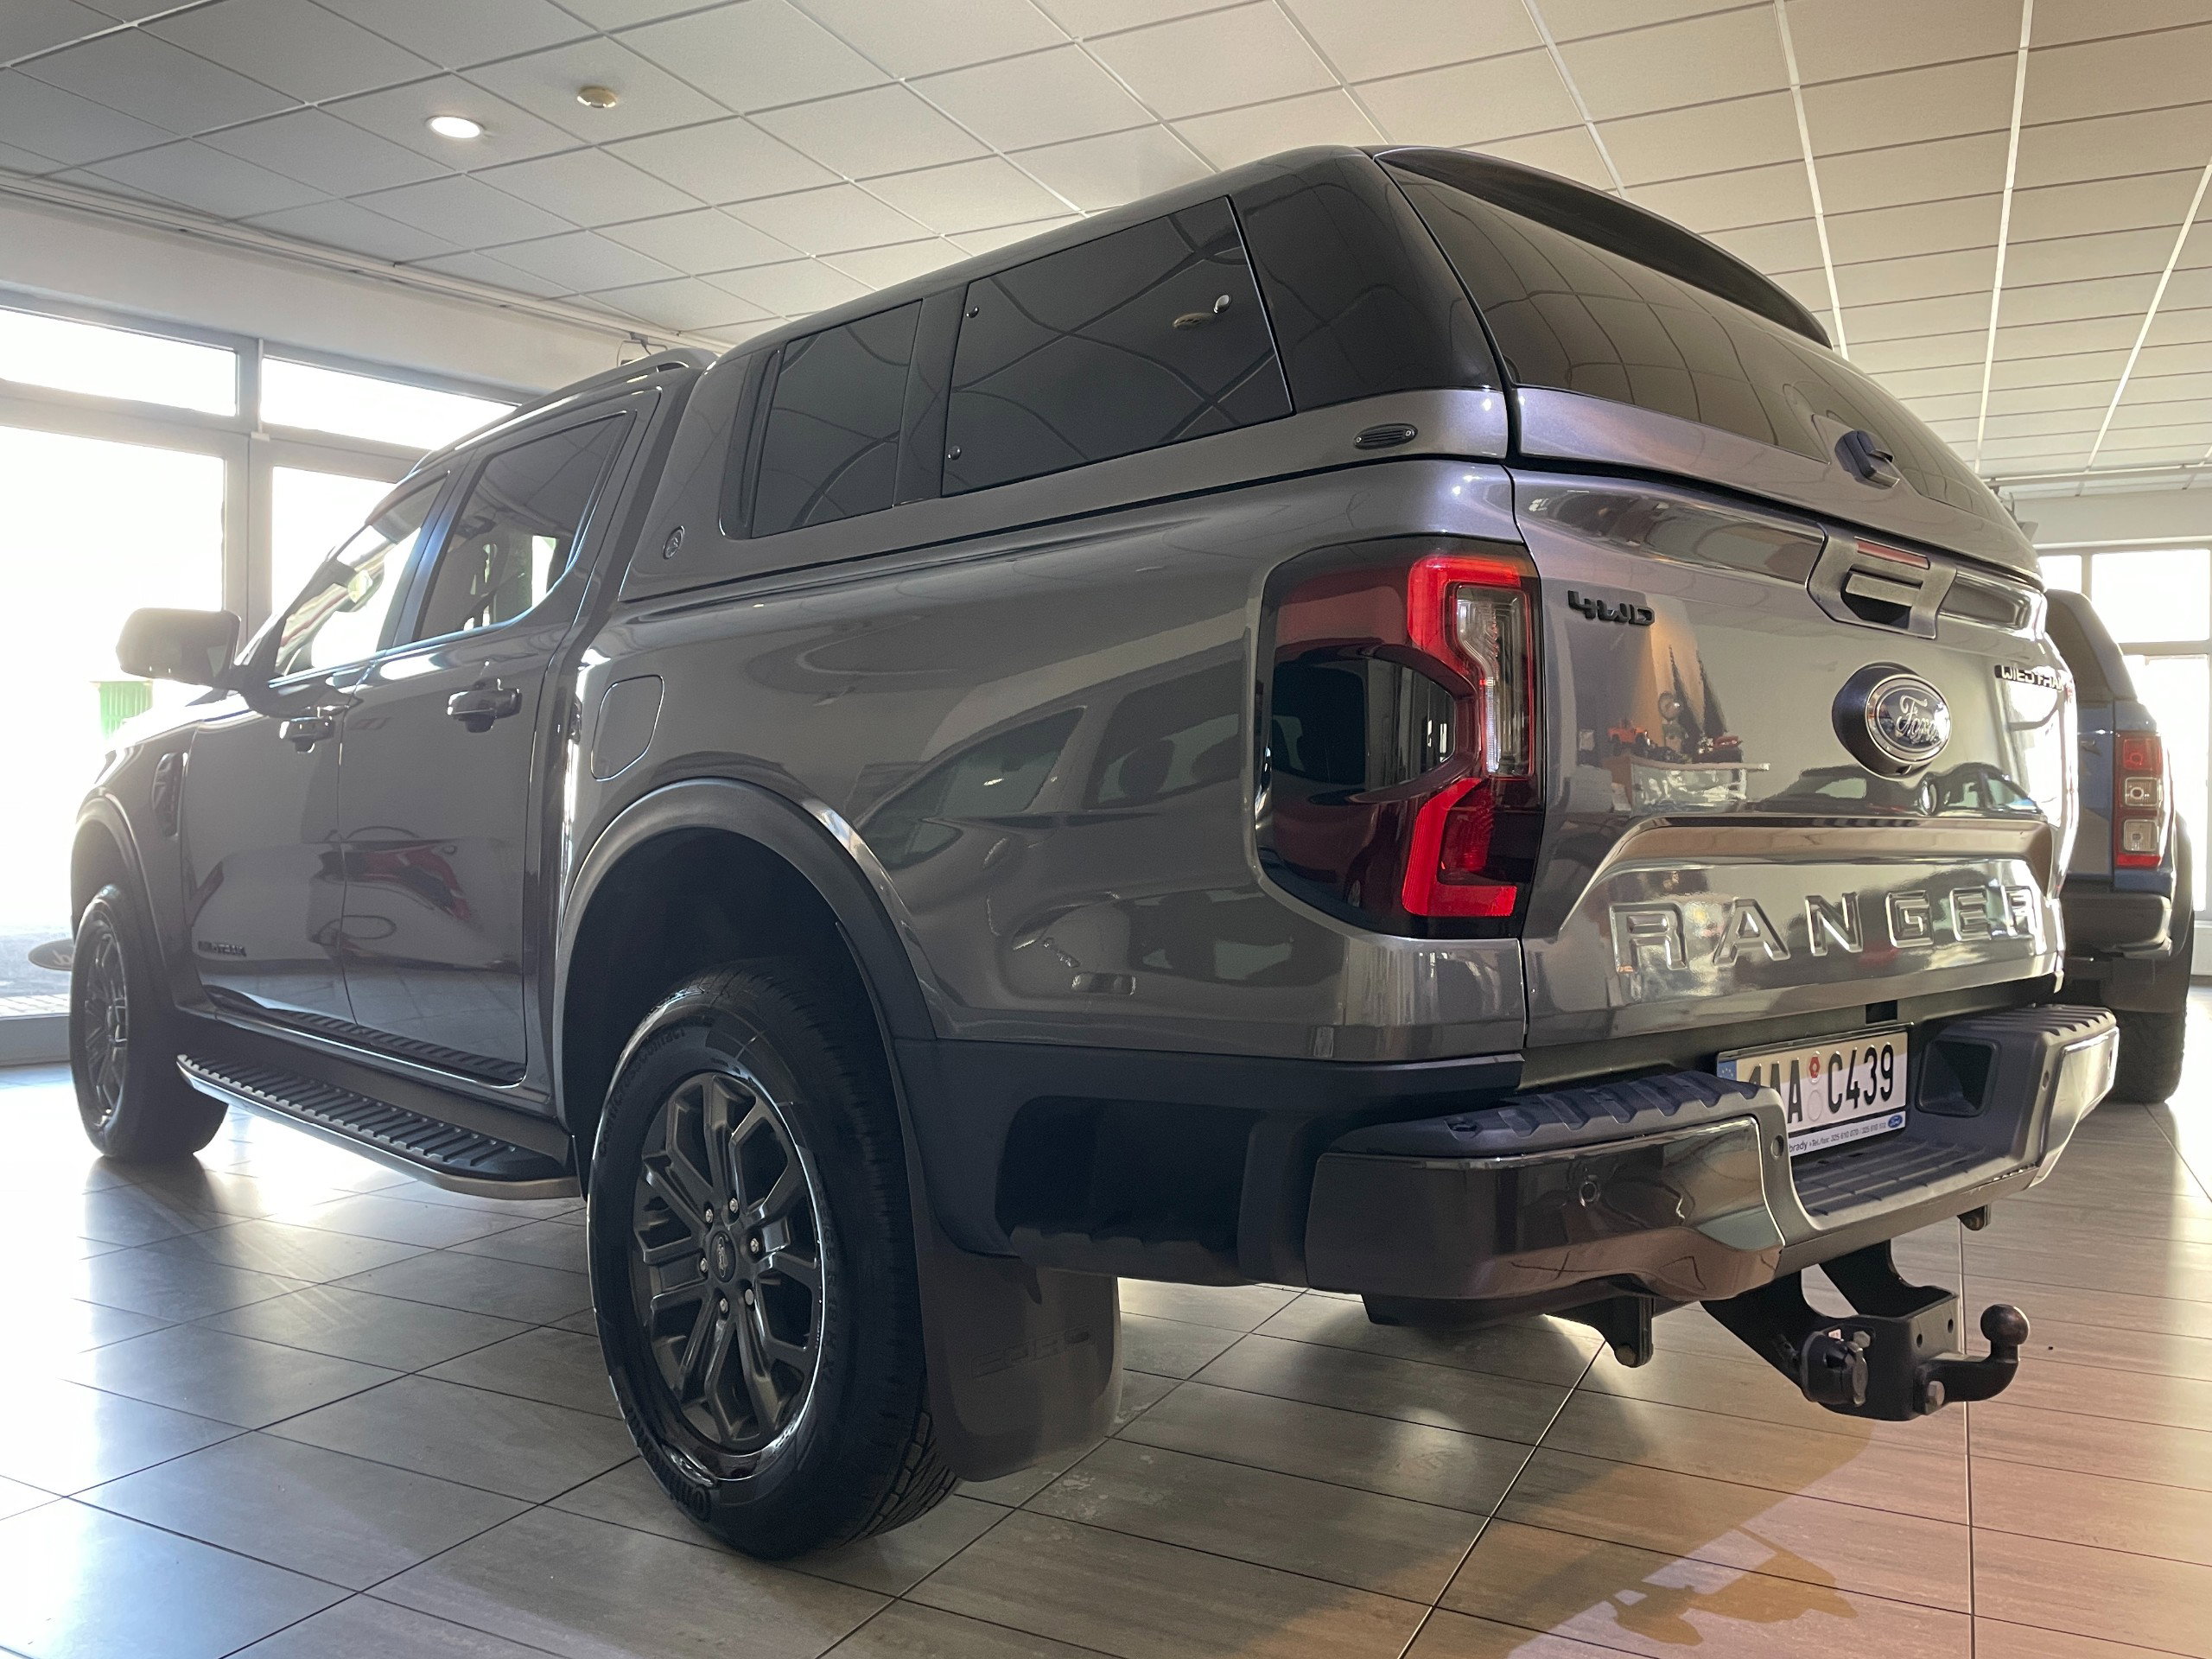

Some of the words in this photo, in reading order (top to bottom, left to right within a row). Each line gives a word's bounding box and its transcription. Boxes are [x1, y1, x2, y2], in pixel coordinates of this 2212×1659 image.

[1567, 590, 1656, 626] 4WD
[1896, 695, 1938, 743] Ford
[1609, 884, 2046, 974] RANGER
[1827, 1042, 1894, 1114] C439
